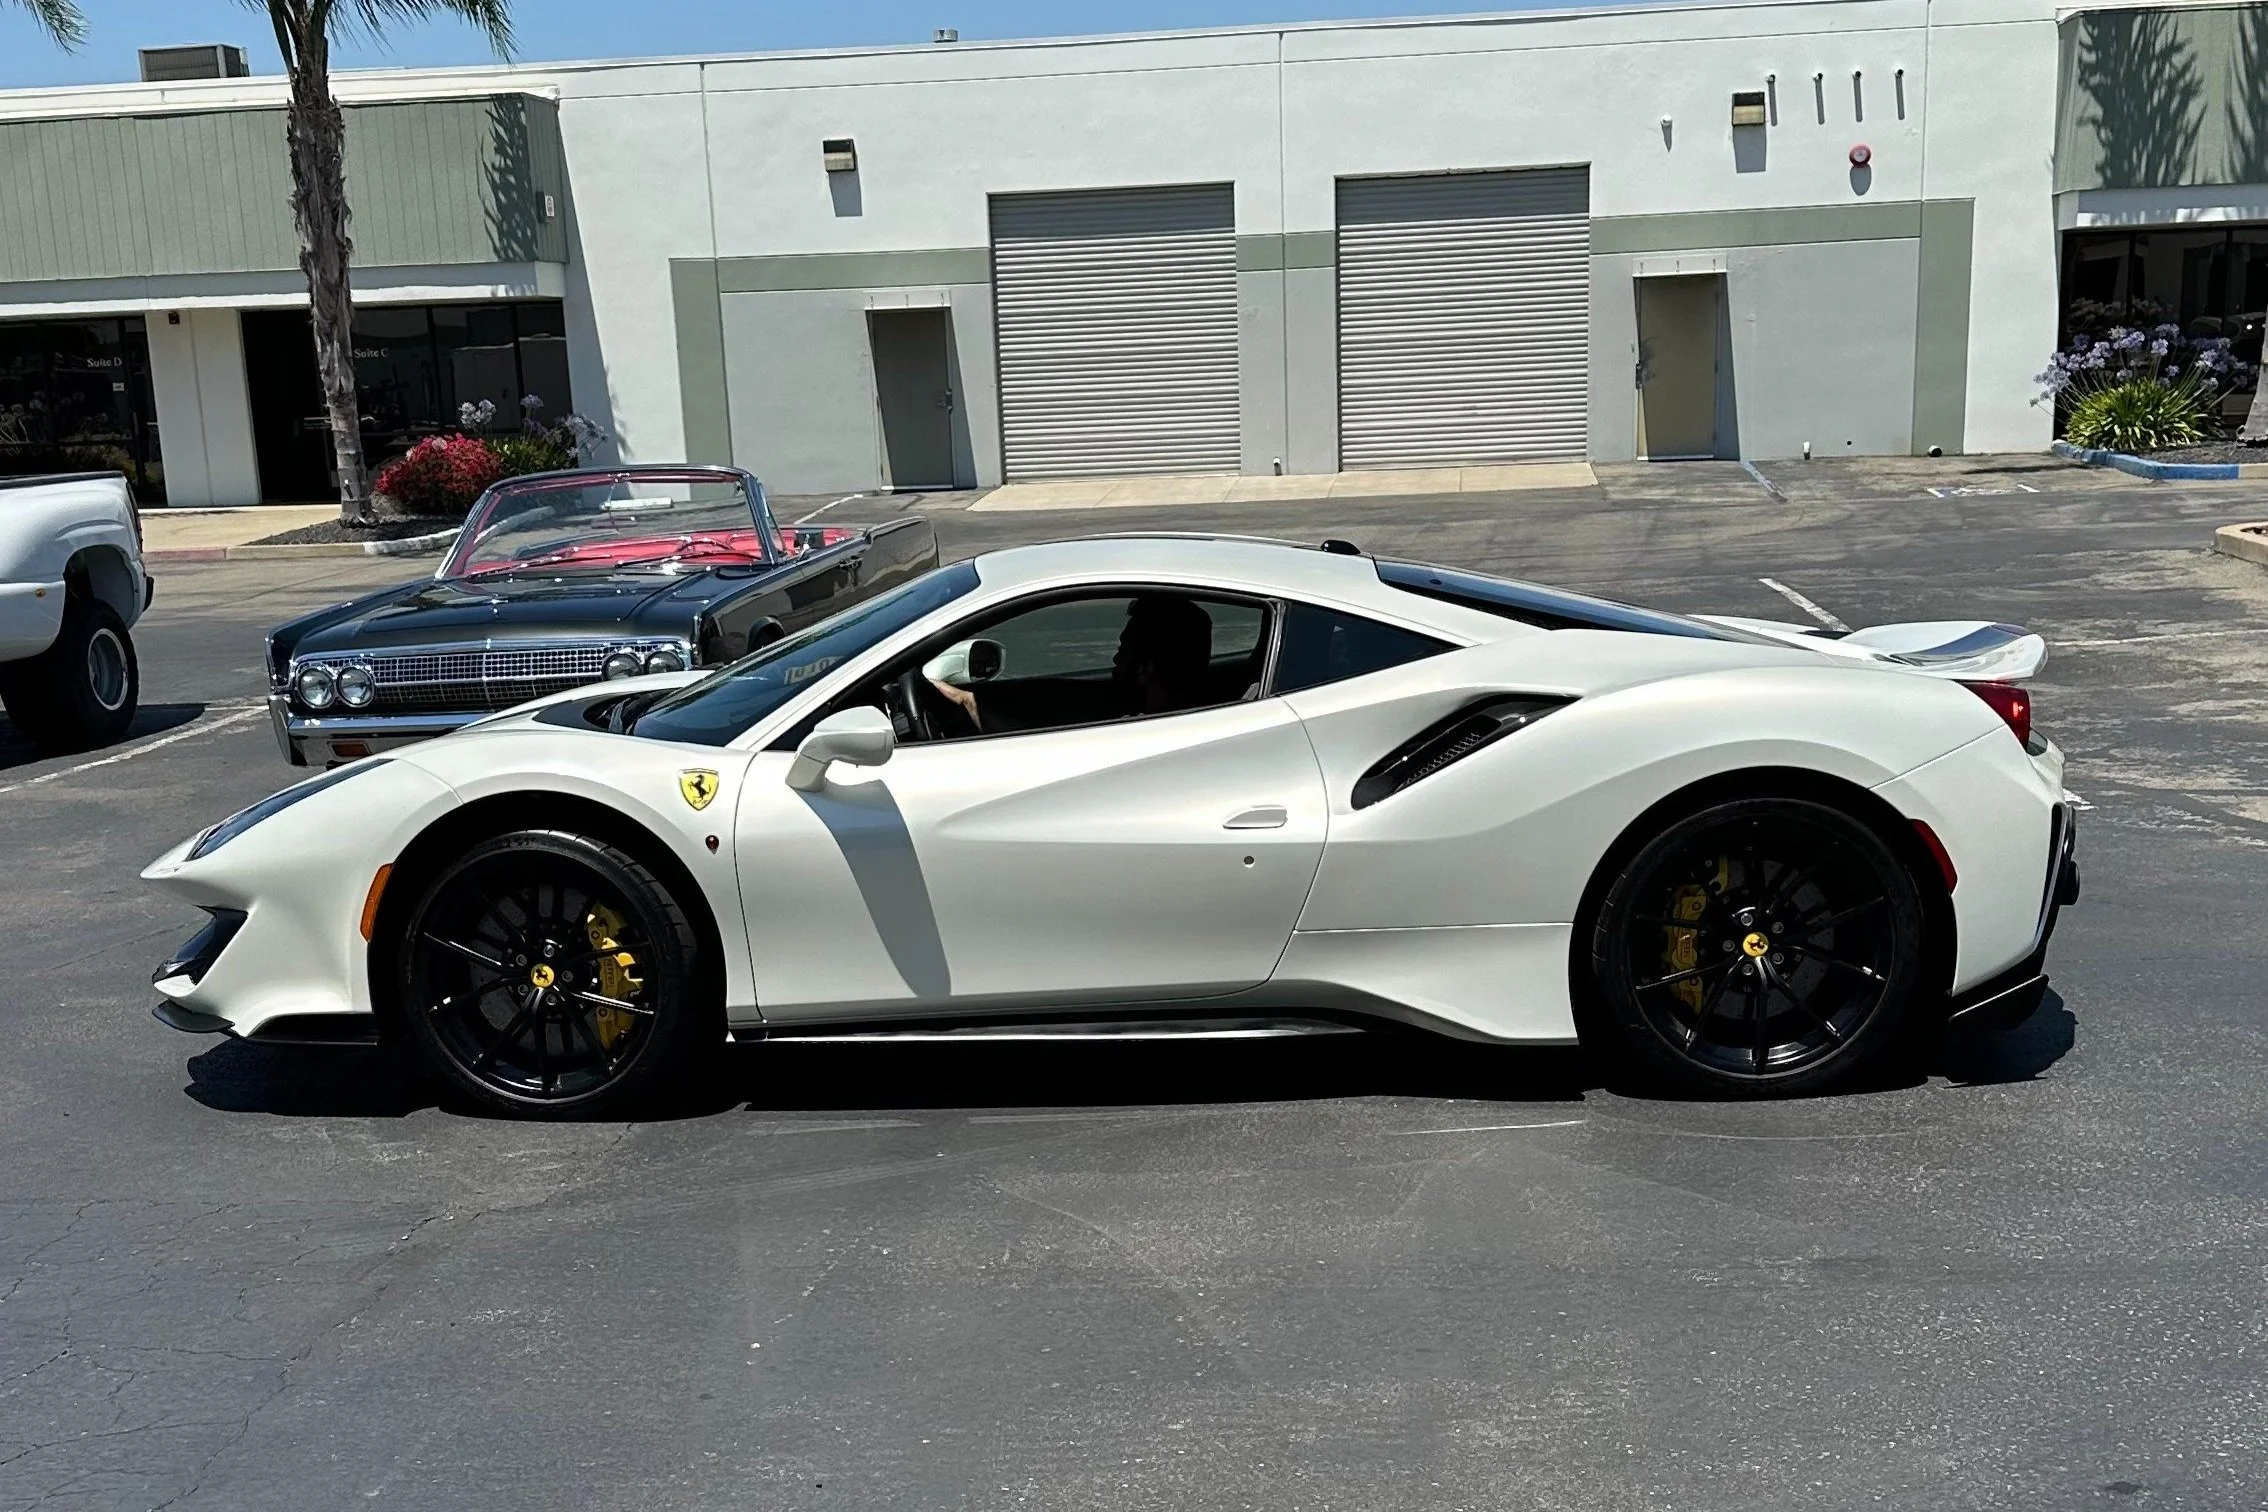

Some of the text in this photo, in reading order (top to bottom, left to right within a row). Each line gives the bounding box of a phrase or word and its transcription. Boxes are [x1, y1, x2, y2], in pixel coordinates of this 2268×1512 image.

[353, 347, 390, 359] Suite C
[87, 356, 123, 368] Suite D
